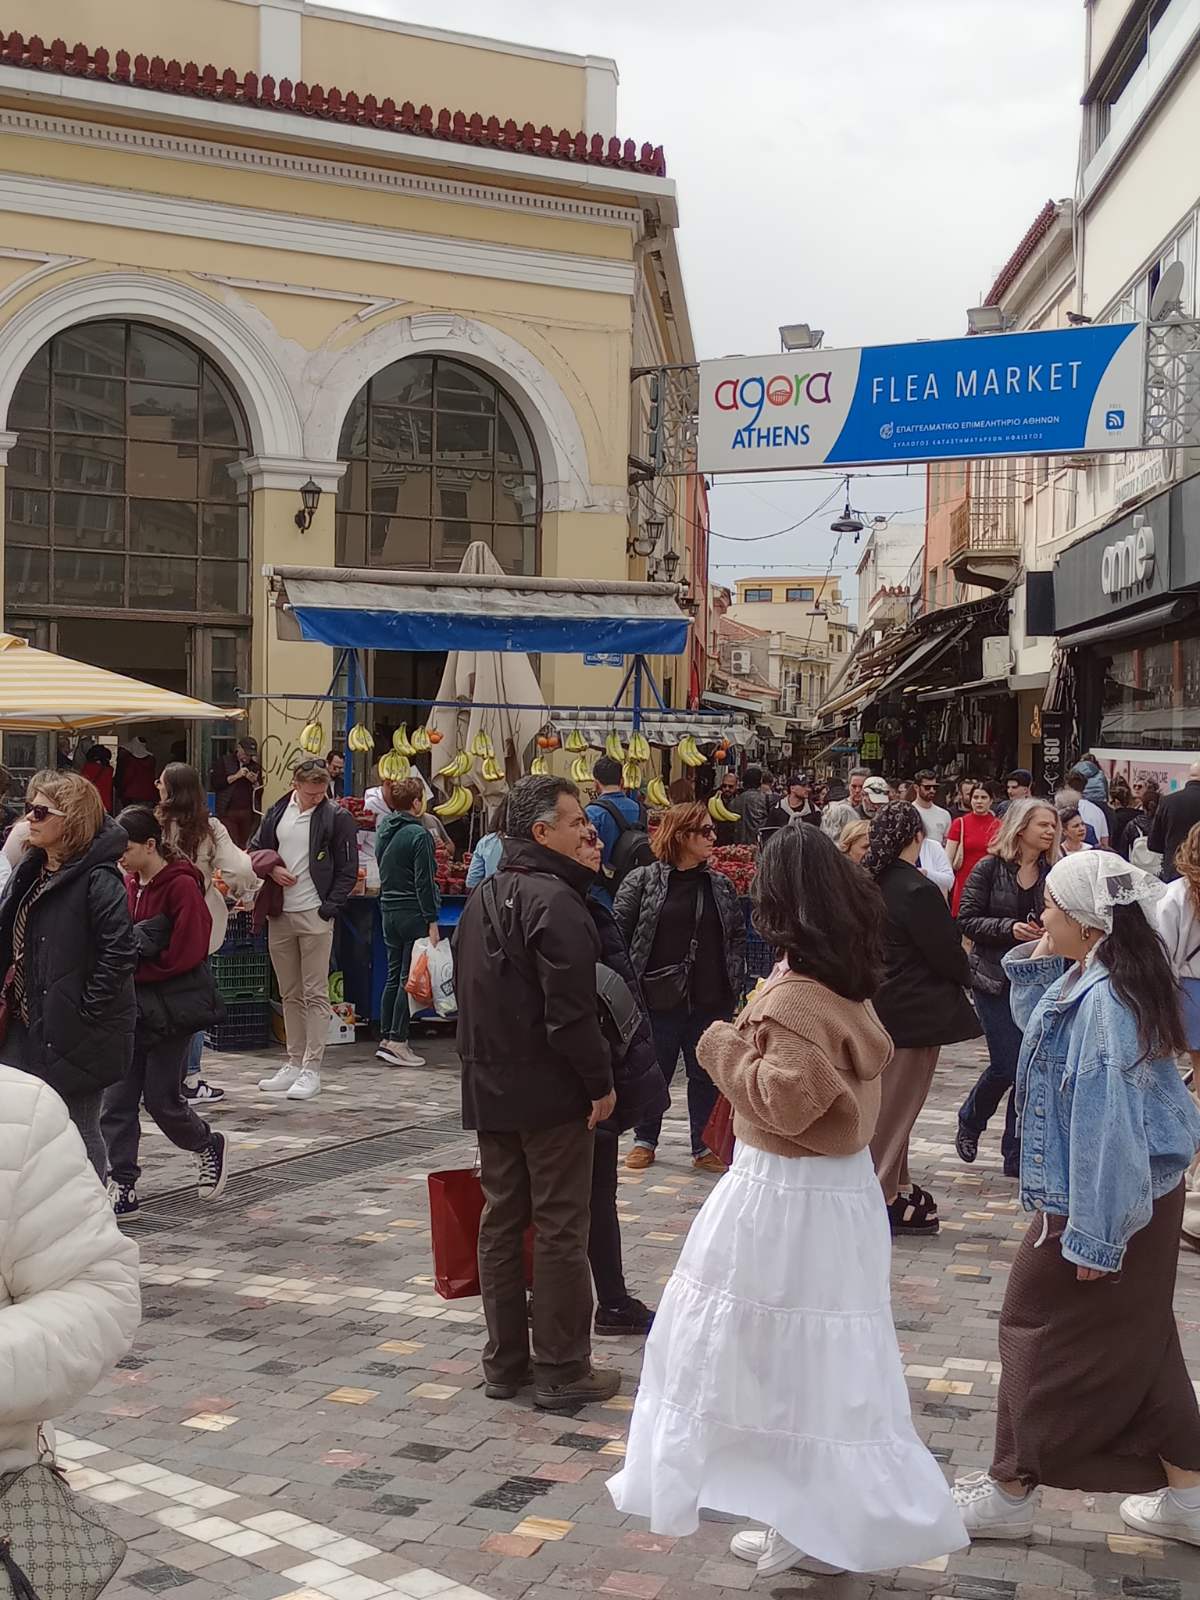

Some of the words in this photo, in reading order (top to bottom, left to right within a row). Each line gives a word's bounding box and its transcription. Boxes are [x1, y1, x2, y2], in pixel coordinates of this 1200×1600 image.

[872, 373, 940, 404] FLEA
[955, 361, 1082, 398] MARKET
[714, 371, 833, 432] agora
[731, 424, 810, 449] ATHENS
[896, 422, 959, 433] ΕΠΑΓΓΕΛΜΑΤΙΚΟ
[961, 418, 1021, 429] ΕΠΙΜΕΛΗΤΗΡΙΟ
[1022, 415, 1060, 425] ΑΘΗΝΩΝ
